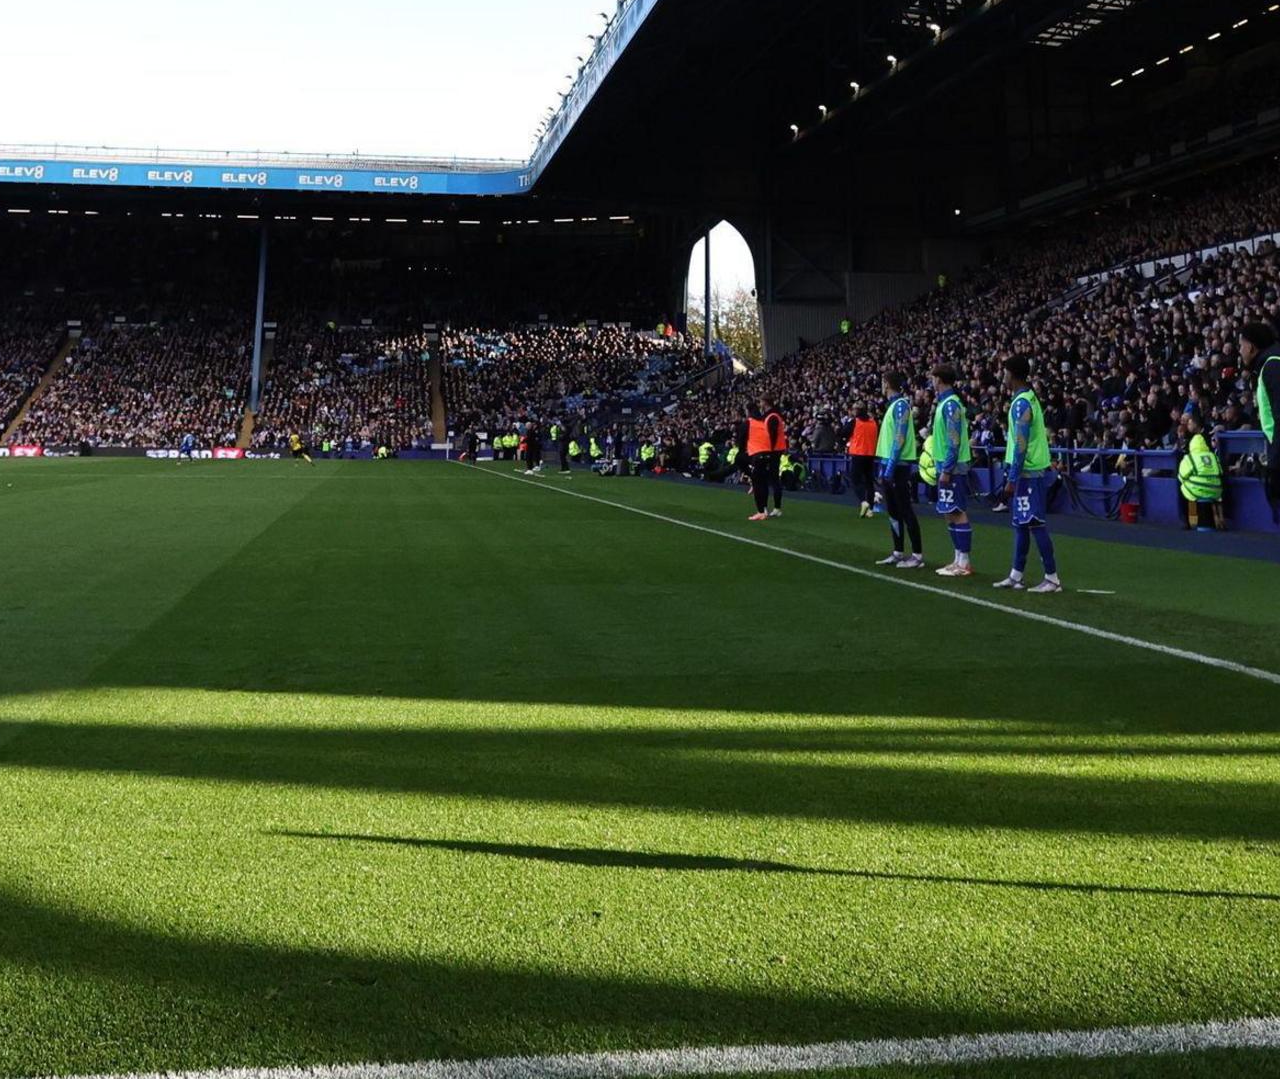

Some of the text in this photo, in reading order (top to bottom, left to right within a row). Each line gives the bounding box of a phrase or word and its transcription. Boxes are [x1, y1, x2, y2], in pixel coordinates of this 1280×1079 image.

[73, 168, 118, 181] ELEV8
[148, 170, 192, 183] ELEV8
[222, 172, 266, 185] ELEV8
[299, 174, 343, 187] ELEV8
[375, 176, 417, 189] ELEV8
[939, 489, 954, 503] 32
[1017, 496, 1030, 511] 33
